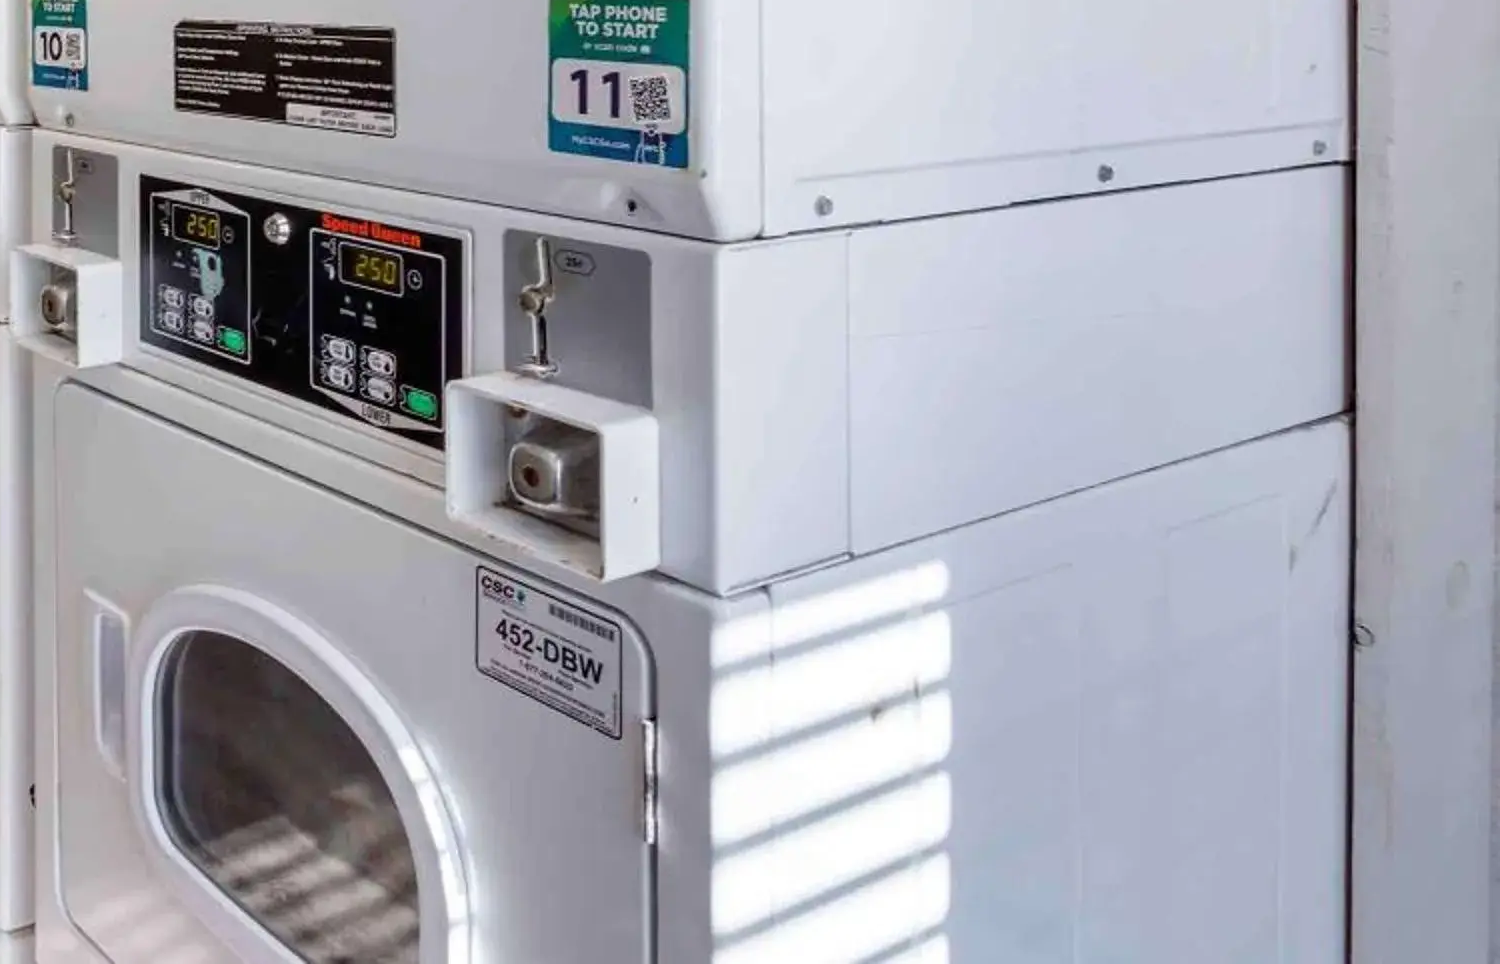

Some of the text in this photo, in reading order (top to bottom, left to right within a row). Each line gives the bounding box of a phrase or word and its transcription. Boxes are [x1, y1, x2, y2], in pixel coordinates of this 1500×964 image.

[569, 4, 668, 22] TAP PHONE
[575, 21, 659, 39] TO START
[40, 32, 63, 60] 10
[570, 69, 621, 119] 11
[187, 213, 218, 239] 250
[322, 212, 421, 249] Speed Queen
[356, 253, 397, 285] 250
[361, 403, 391, 425] LOWER
[481, 575, 515, 599] CSC
[496, 618, 604, 685] 452-DBW
